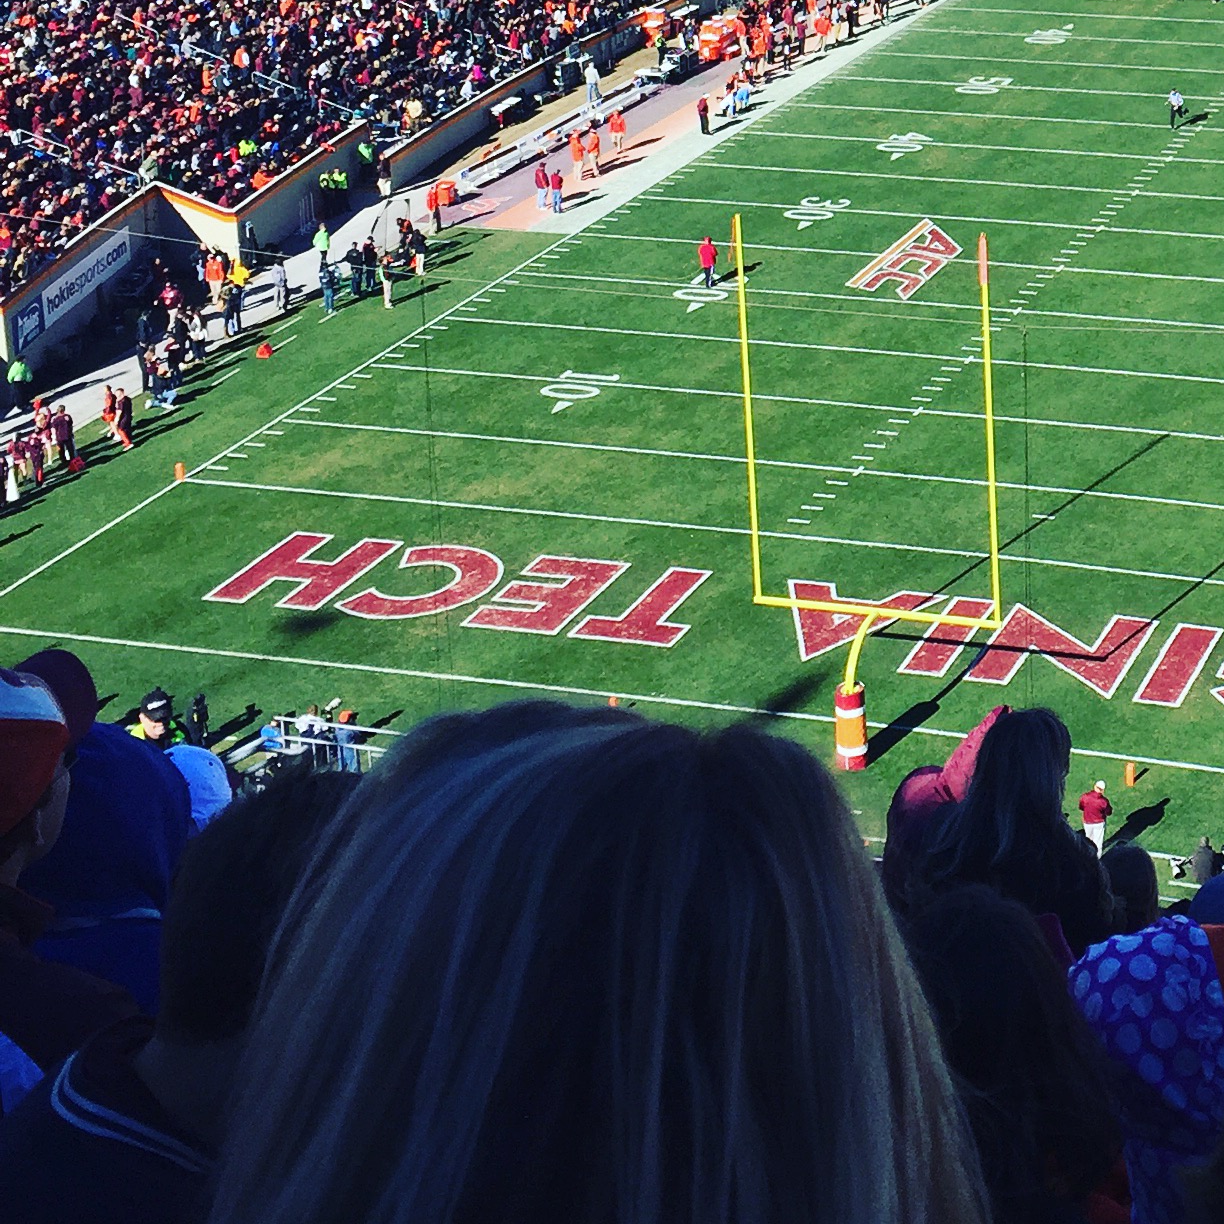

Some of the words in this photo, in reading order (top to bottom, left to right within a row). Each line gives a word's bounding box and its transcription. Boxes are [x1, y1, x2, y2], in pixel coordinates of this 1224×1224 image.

[955, 76, 1014, 94] 50
[876, 132, 933, 153] 40
[783, 196, 851, 221] 30
[861, 223, 964, 301] ACC
[46, 241, 127, 315] hokiesports.com
[540, 369, 620, 399] 10
[201, 531, 714, 648] TECH
